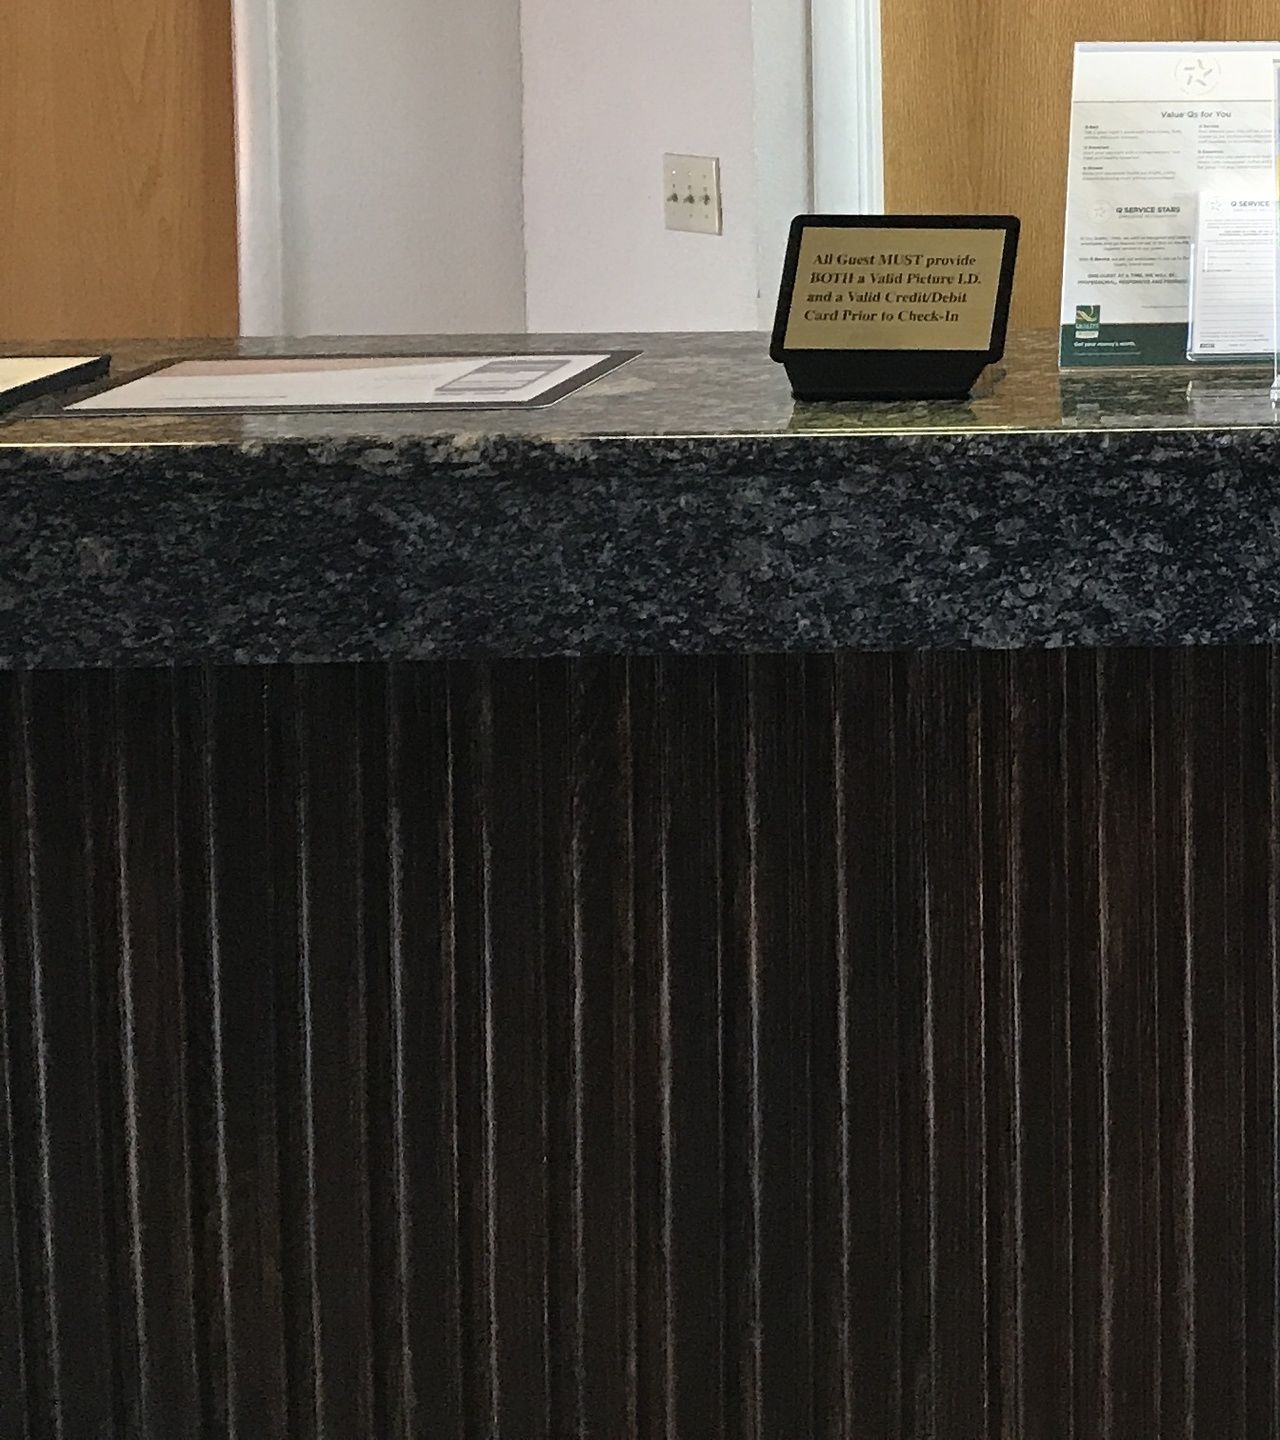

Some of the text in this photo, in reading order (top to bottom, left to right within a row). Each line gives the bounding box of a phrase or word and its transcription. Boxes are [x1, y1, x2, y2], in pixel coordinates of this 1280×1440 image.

[1187, 111, 1198, 119] Qs
[813, 254, 976, 269] All Guest MUST provide
[810, 272, 982, 284] BOTH a Valid Picture I.D.
[807, 291, 967, 303] and a Valid Credit/Debit
[804, 310, 959, 321] Card Prior to Check-In
